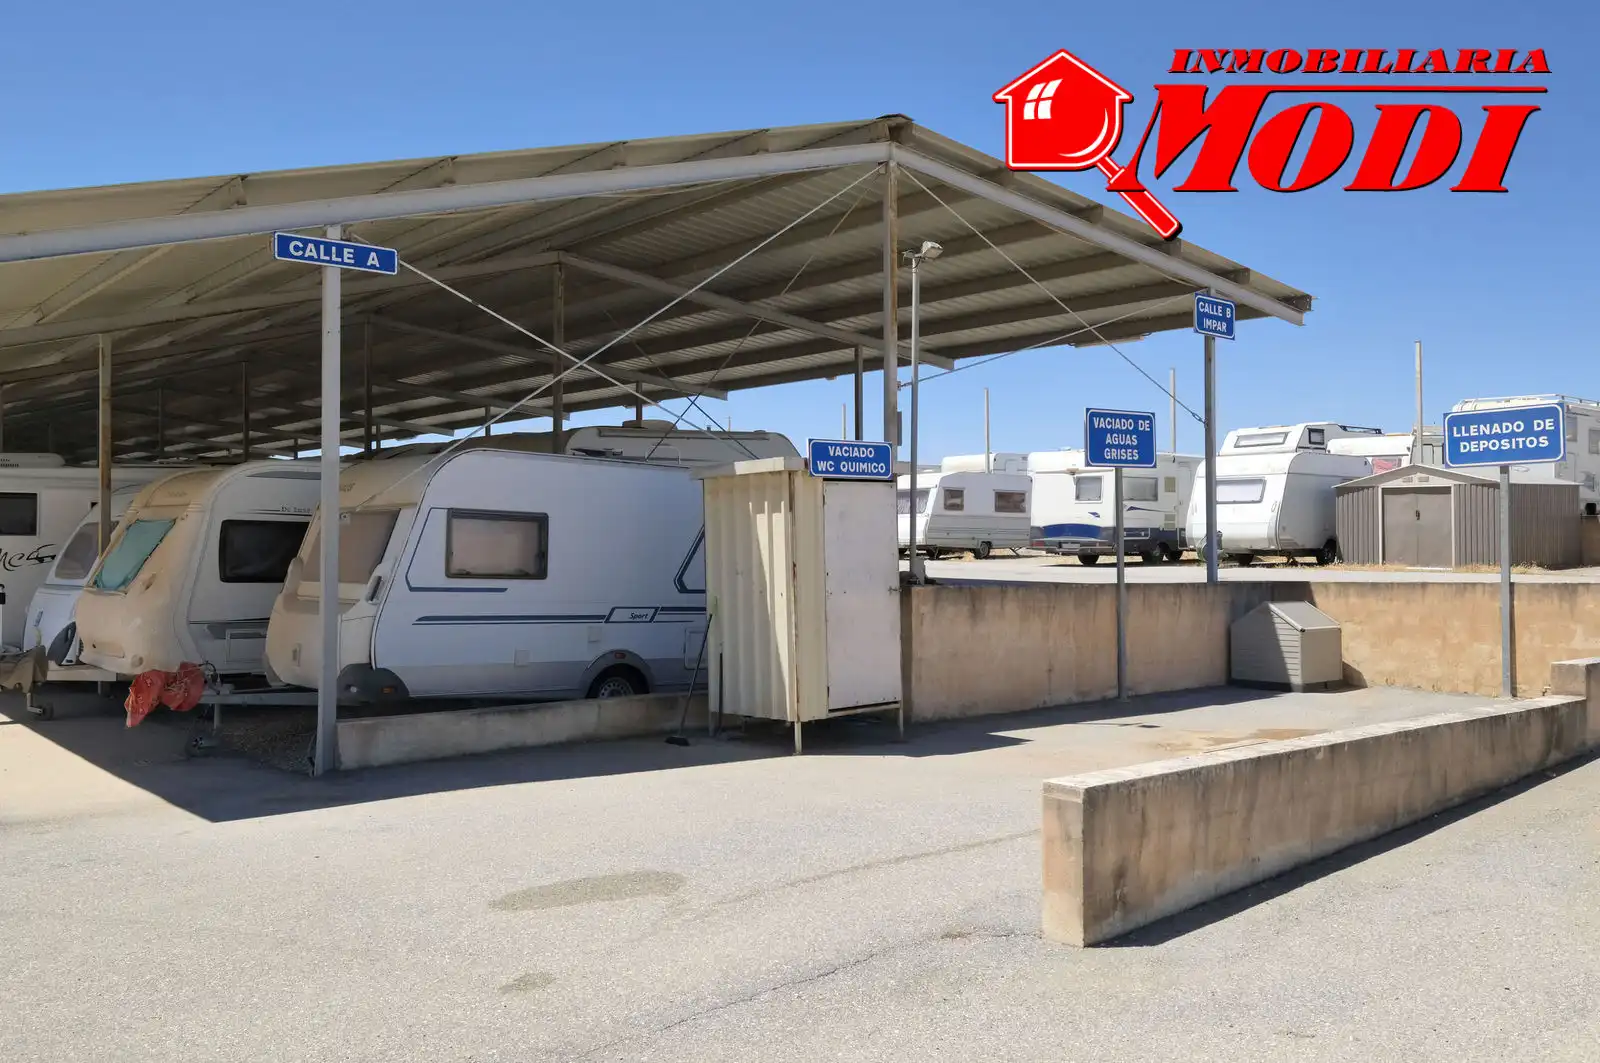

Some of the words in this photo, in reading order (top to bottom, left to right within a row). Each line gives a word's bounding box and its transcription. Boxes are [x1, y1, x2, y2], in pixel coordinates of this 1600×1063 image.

[288, 240, 355, 264] CALLE
[366, 251, 380, 268] A
[1198, 301, 1223, 317] CALLE
[1226, 307, 1232, 319] B
[1203, 317, 1227, 333] IMPAR
[1093, 416, 1134, 430] VACIADO
[1138, 419, 1151, 432] DE
[1452, 421, 1525, 438] LLENADO
[1533, 418, 1555, 431] DE
[1105, 433, 1138, 446] AGUAS
[1459, 436, 1550, 453] DEPOSITOS
[828, 445, 875, 458] VACIADO
[1104, 448, 1139, 461] GRISES
[816, 460, 835, 472] WC
[840, 461, 886, 474] QUIMICO
[629, 611, 649, 621] Sport
